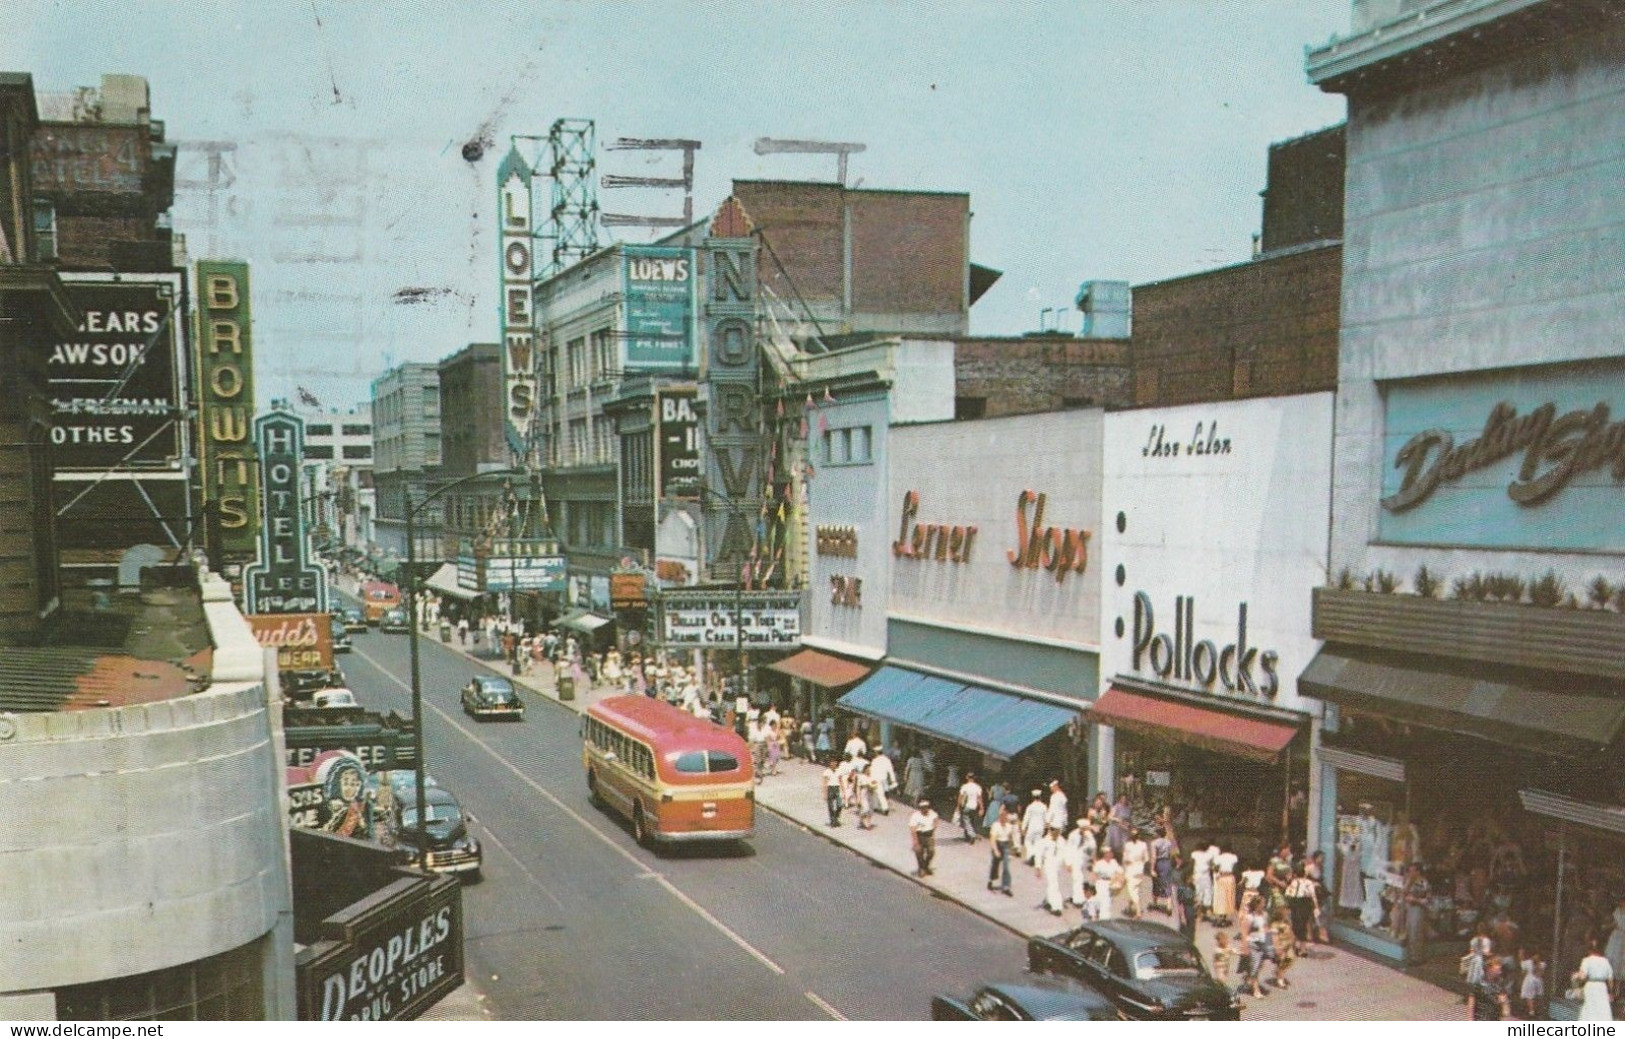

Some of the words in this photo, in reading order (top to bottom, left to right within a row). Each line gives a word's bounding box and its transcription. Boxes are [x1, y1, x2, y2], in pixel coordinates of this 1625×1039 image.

[662, 398, 698, 422] BA
[712, 251, 757, 562] NORVA
[1187, 420, 1232, 455] Salon
[266, 428, 294, 563] HOTEL
[893, 490, 978, 563] Lerner
[1007, 488, 1092, 584] Shops
[259, 577, 314, 591] LEE
[1132, 590, 1279, 699] Pollocks
[400, 955, 445, 1002] STORE
